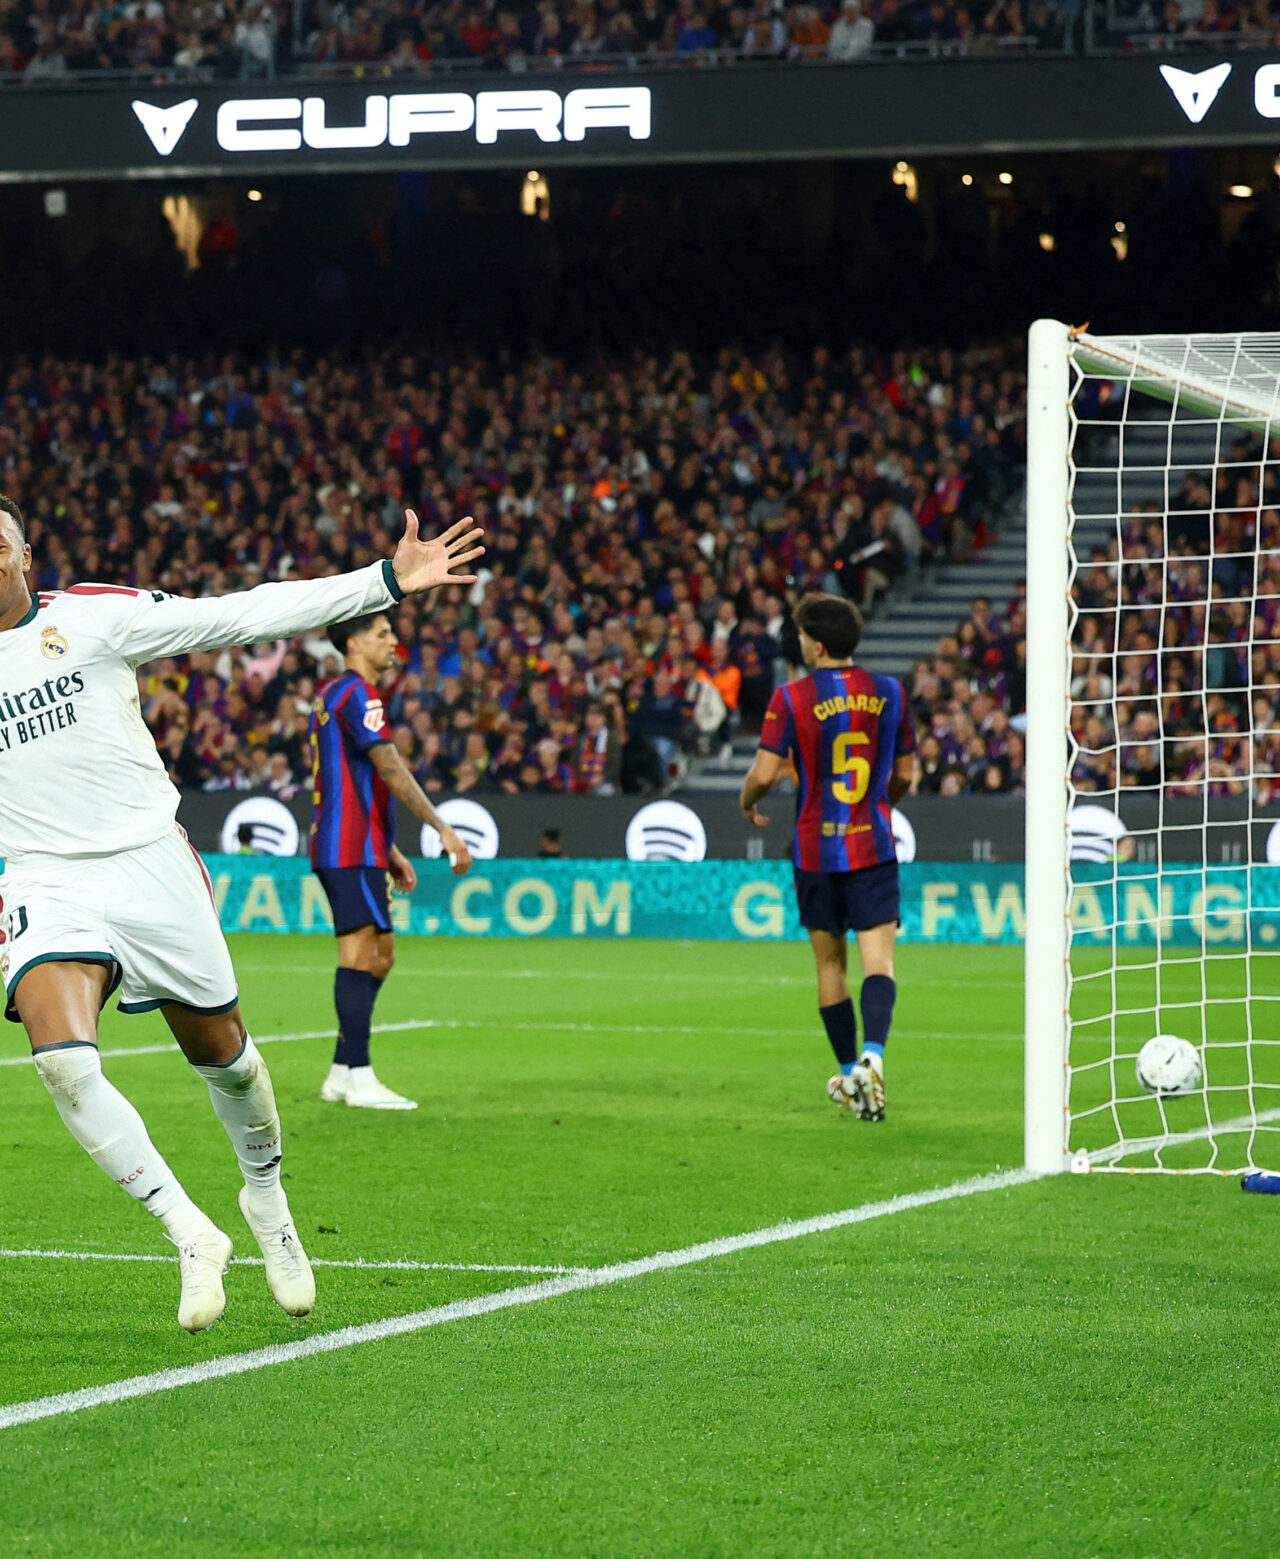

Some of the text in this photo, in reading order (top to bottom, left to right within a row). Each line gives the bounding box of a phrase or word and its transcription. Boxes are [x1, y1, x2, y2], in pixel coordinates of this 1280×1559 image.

[216, 86, 652, 151] CUPRA
[15, 702, 78, 745] BETTER
[831, 730, 871, 805] 5
